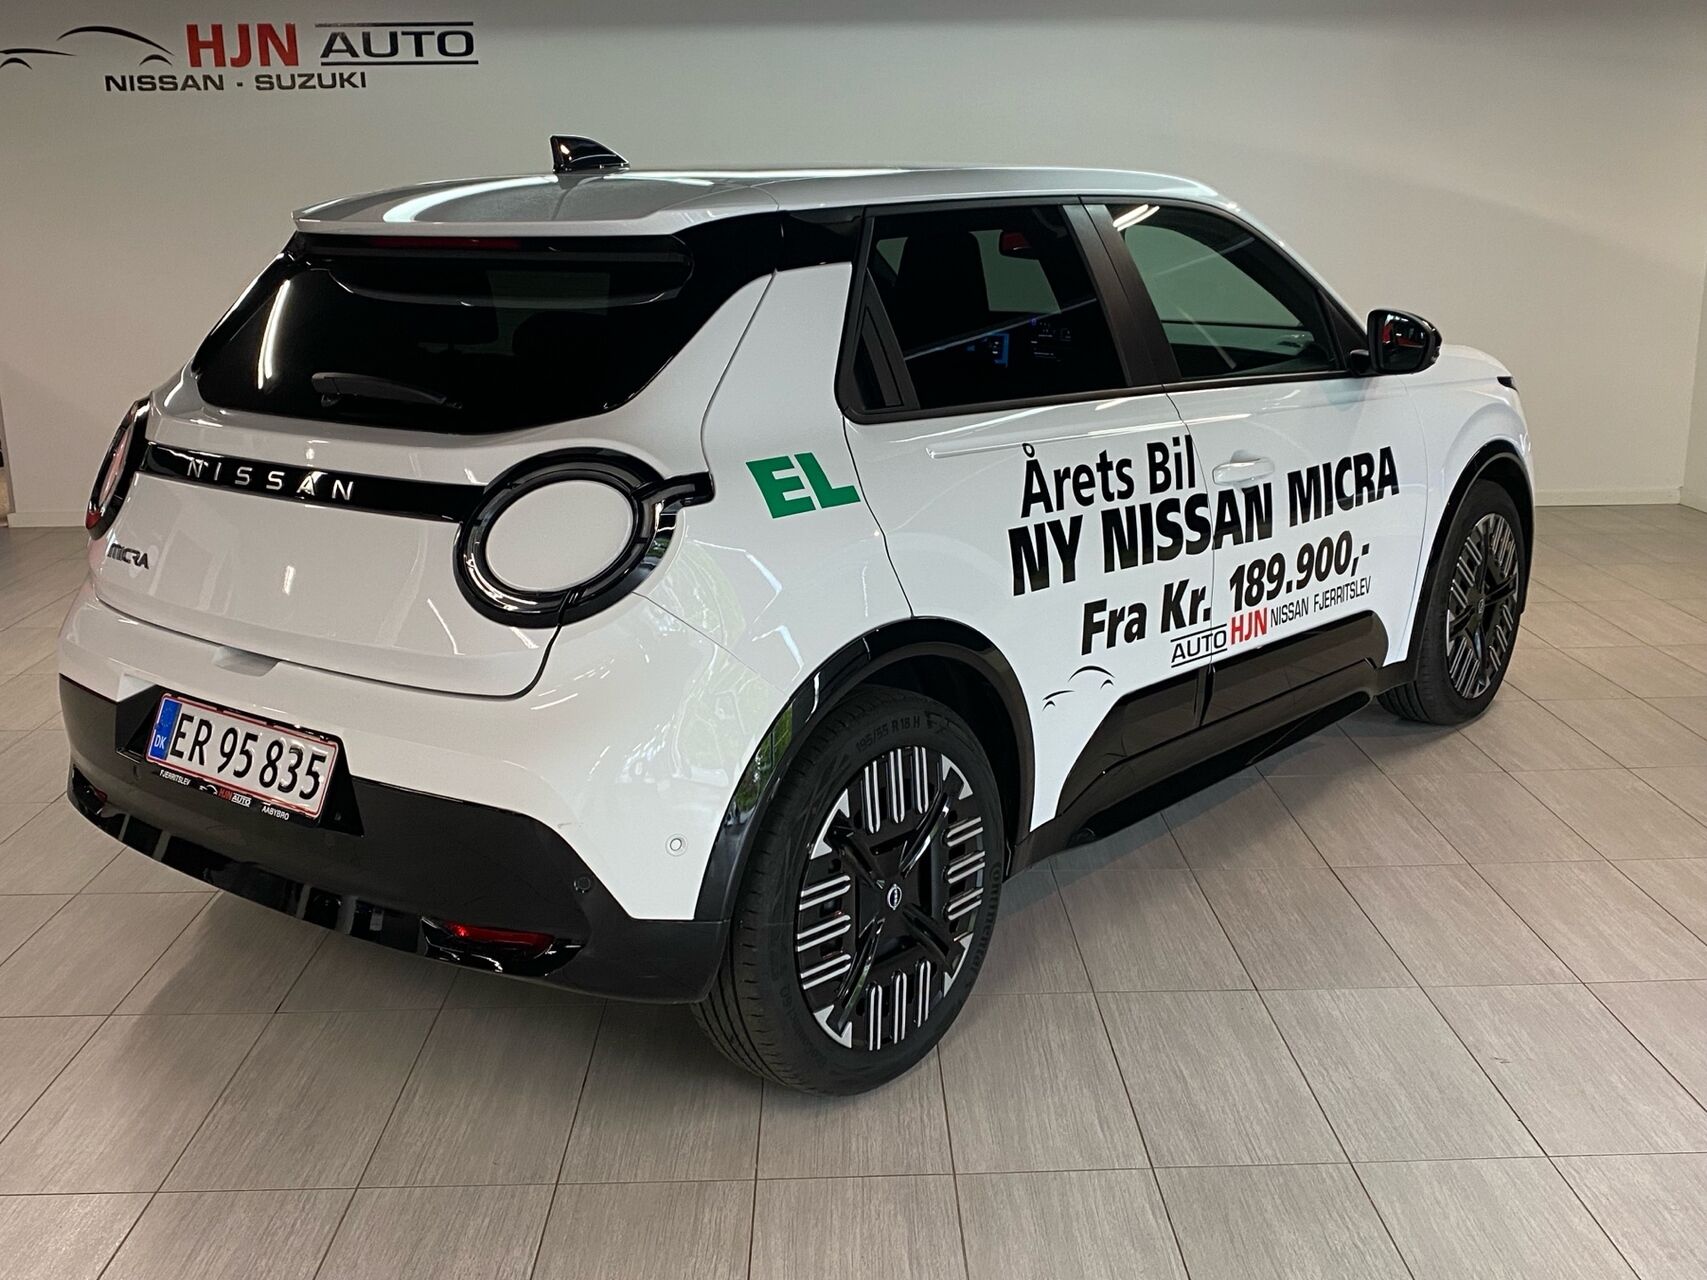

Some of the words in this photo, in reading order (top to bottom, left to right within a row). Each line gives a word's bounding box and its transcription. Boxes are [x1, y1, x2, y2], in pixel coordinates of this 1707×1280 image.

[186, 22, 299, 68] HJN
[320, 29, 475, 59] AUTO
[105, 73, 225, 93] NISSAN
[255, 72, 366, 91] SUZUKI
[187, 459, 354, 500] NISSAN
[745, 452, 861, 519] EL
[1020, 442, 1135, 518] Årets
[1147, 434, 1196, 495] Bil
[1008, 514, 1083, 597] NY
[1100, 482, 1273, 574] NISSAN
[1287, 445, 1400, 527] MICRA
[107, 543, 149, 570] MICRA
[1081, 598, 1147, 656] Fra
[1160, 578, 1211, 634] Kr.
[1229, 530, 1370, 613] 189.900,-
[1171, 630, 1227, 664] AUTO
[1231, 607, 1268, 645] HJN
[1270, 597, 1309, 629] NISSAN
[1313, 576, 1372, 613] FJERRITSLEV
[154, 734, 167, 751] DK
[170, 713, 212, 766] ER
[217, 727, 258, 779] 95
[259, 740, 327, 800] 835
